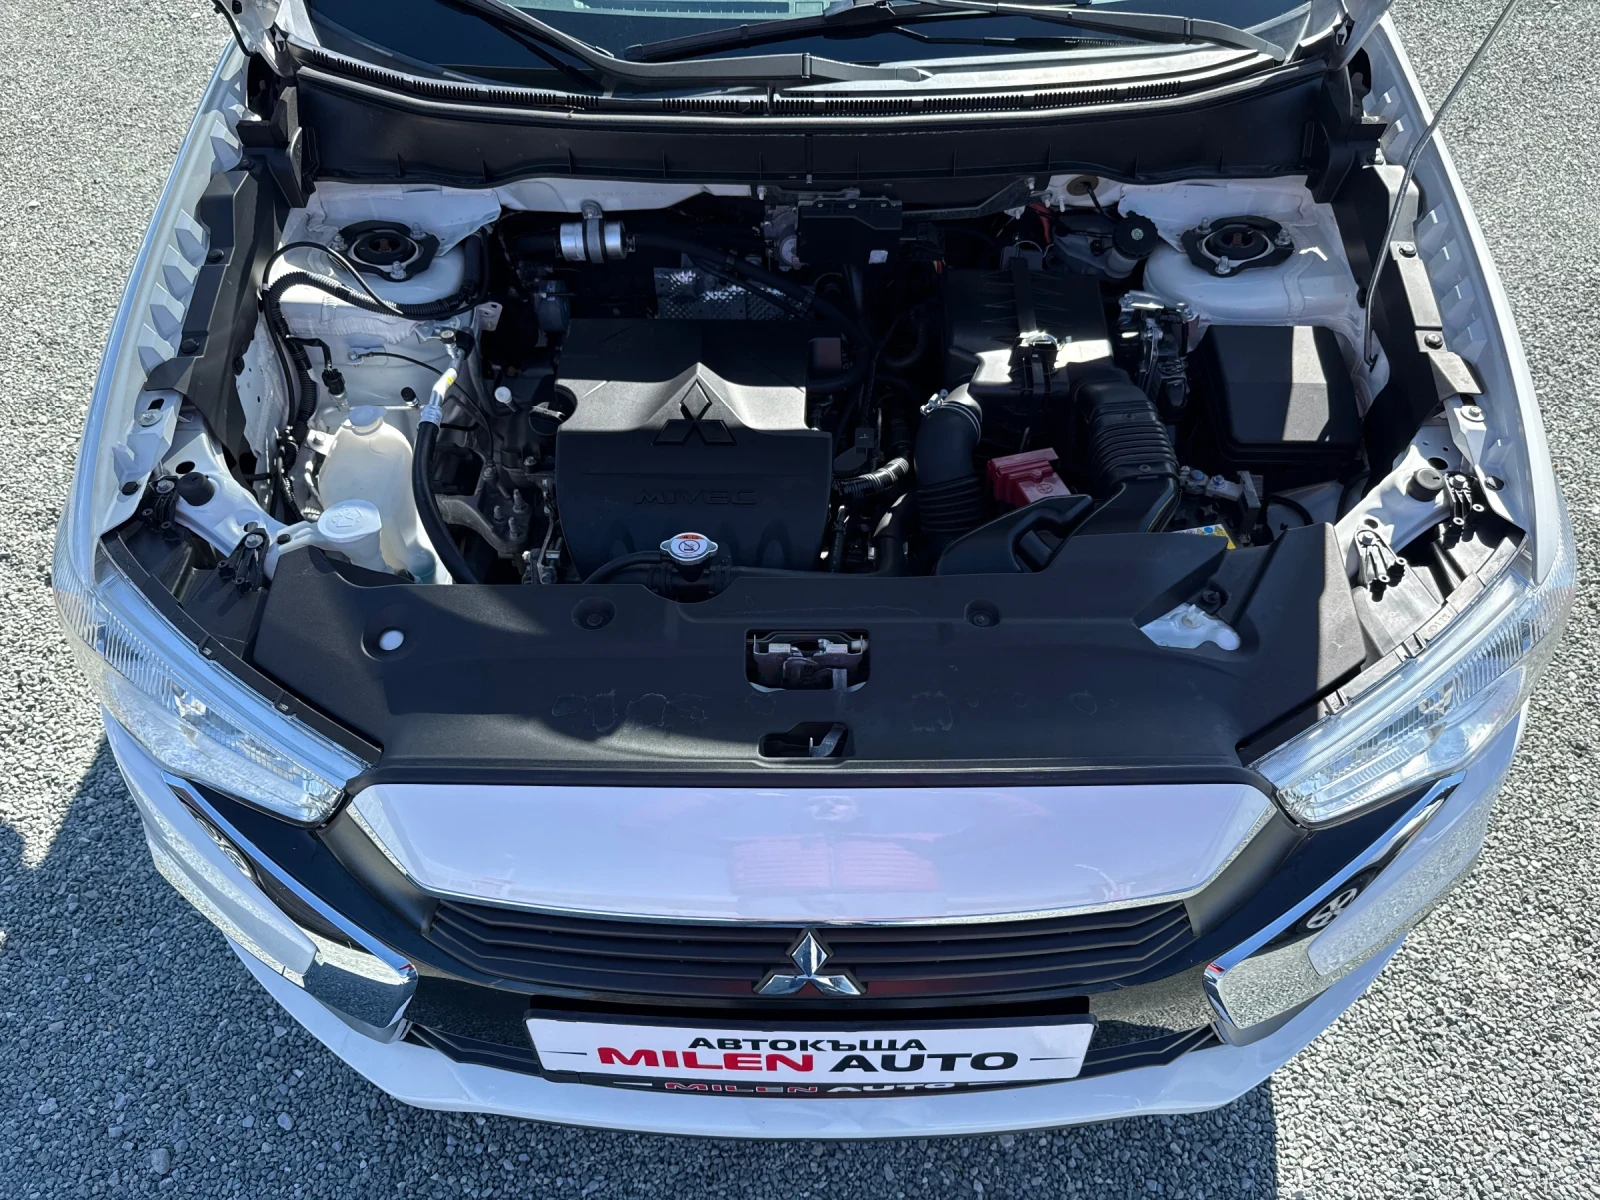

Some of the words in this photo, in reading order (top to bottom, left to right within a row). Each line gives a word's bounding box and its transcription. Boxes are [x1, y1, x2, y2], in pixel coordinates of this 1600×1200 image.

[635, 488, 756, 505] MIVEC
[597, 1047, 814, 1072] MILEN
[828, 1052, 1019, 1072] AUTO
[664, 1082, 818, 1093] MILEN
[826, 1082, 955, 1093] AUTO
